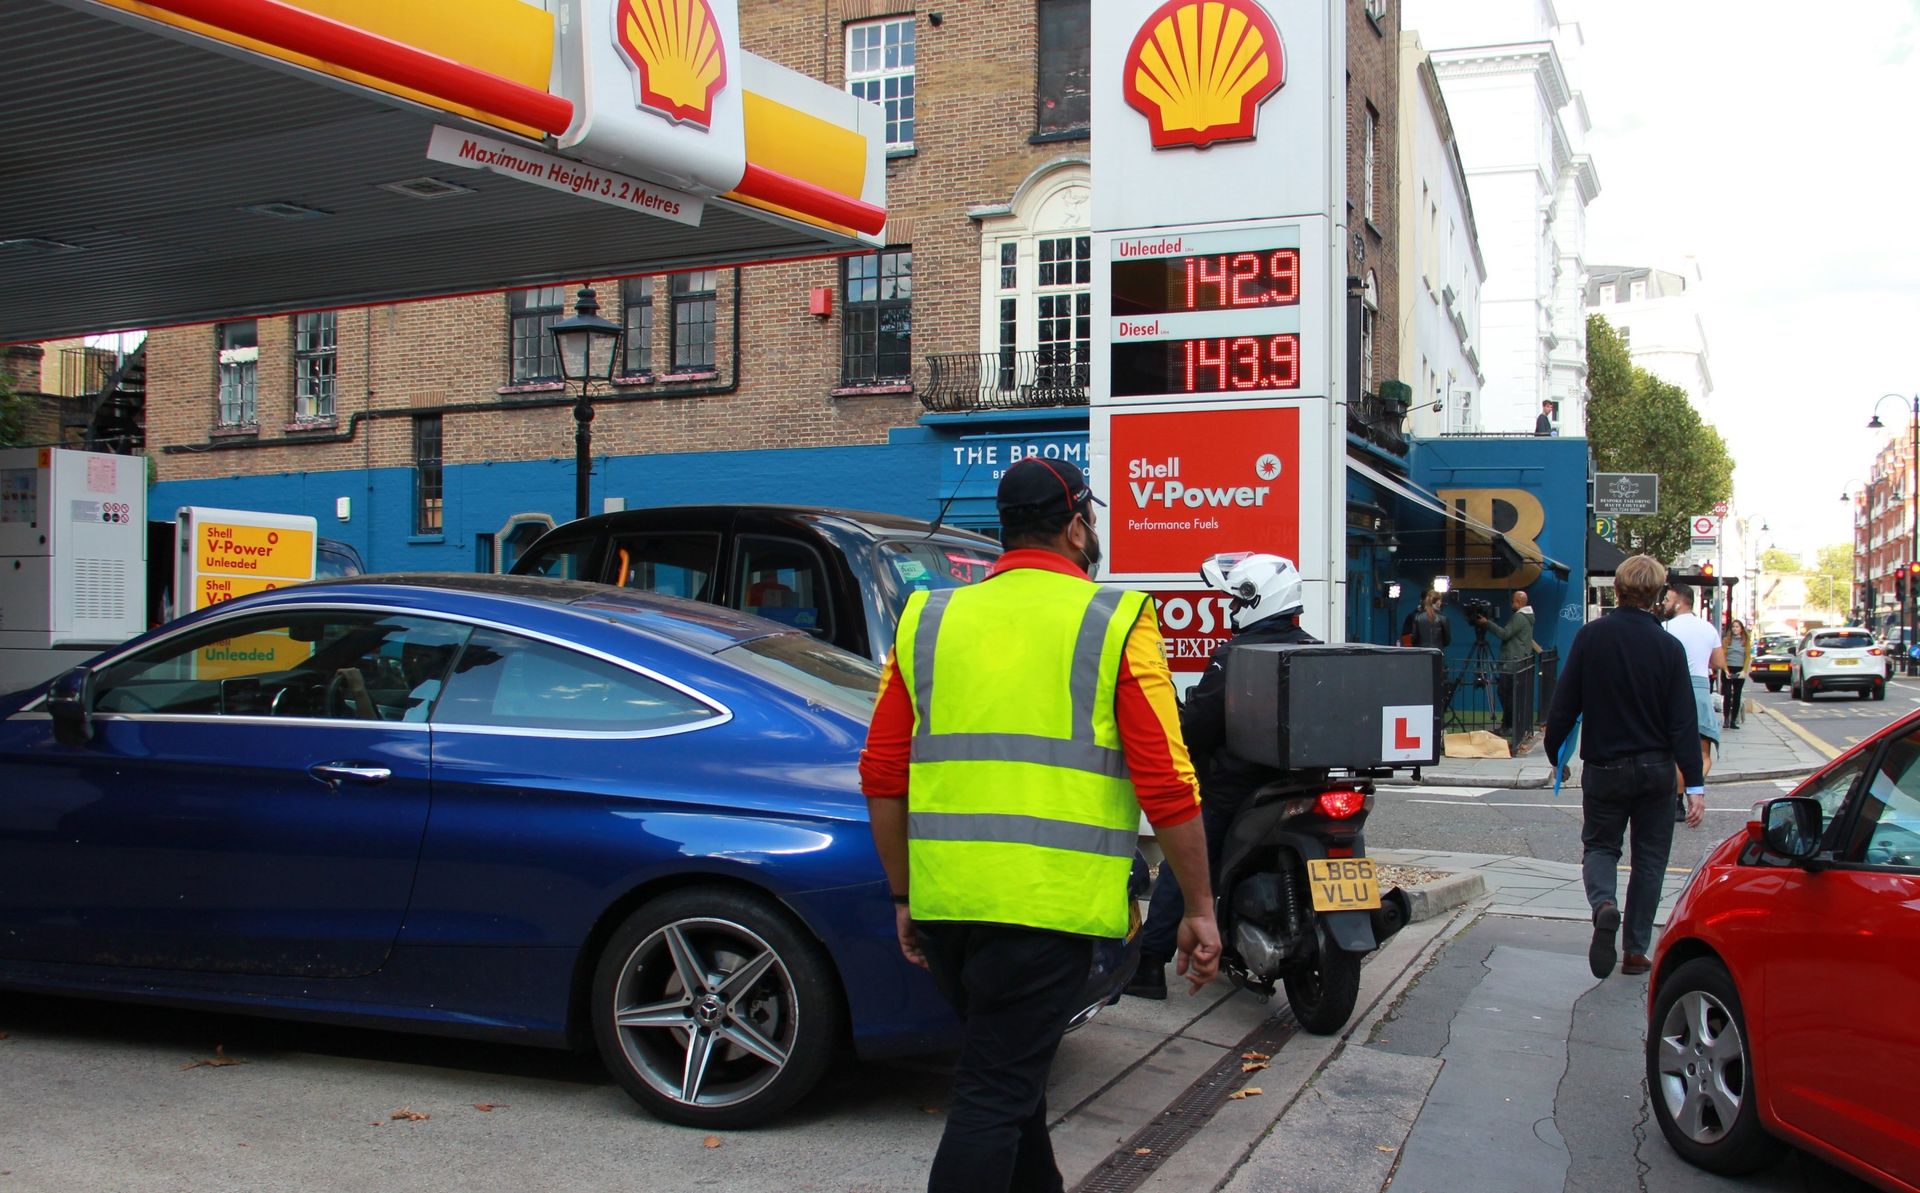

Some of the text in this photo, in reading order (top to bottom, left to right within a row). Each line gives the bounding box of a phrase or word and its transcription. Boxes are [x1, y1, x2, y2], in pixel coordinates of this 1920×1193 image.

[458, 139, 681, 215] Maximum Height 3.2 Metres
[1119, 238, 1182, 257] Unleaded
[1185, 251, 1298, 308] 142.9
[1119, 320, 1159, 336] Diesel
[1184, 336, 1298, 391] 143.9
[953, 446, 997, 465] THE
[1128, 457, 1180, 479] Shell
[1129, 480, 1270, 509] V-Power
[207, 527, 232, 539] Shell
[1129, 517, 1219, 531] Performance Fuels
[207, 539, 273, 557] V-Power
[206, 557, 257, 570] Unleaded
[206, 580, 231, 591] Shell
[1155, 597, 1234, 634] OST
[205, 647, 275, 661] Unleaded
[1395, 717, 1421, 750] L
[1311, 861, 1373, 882] LB66
[1322, 882, 1369, 903] VLU
